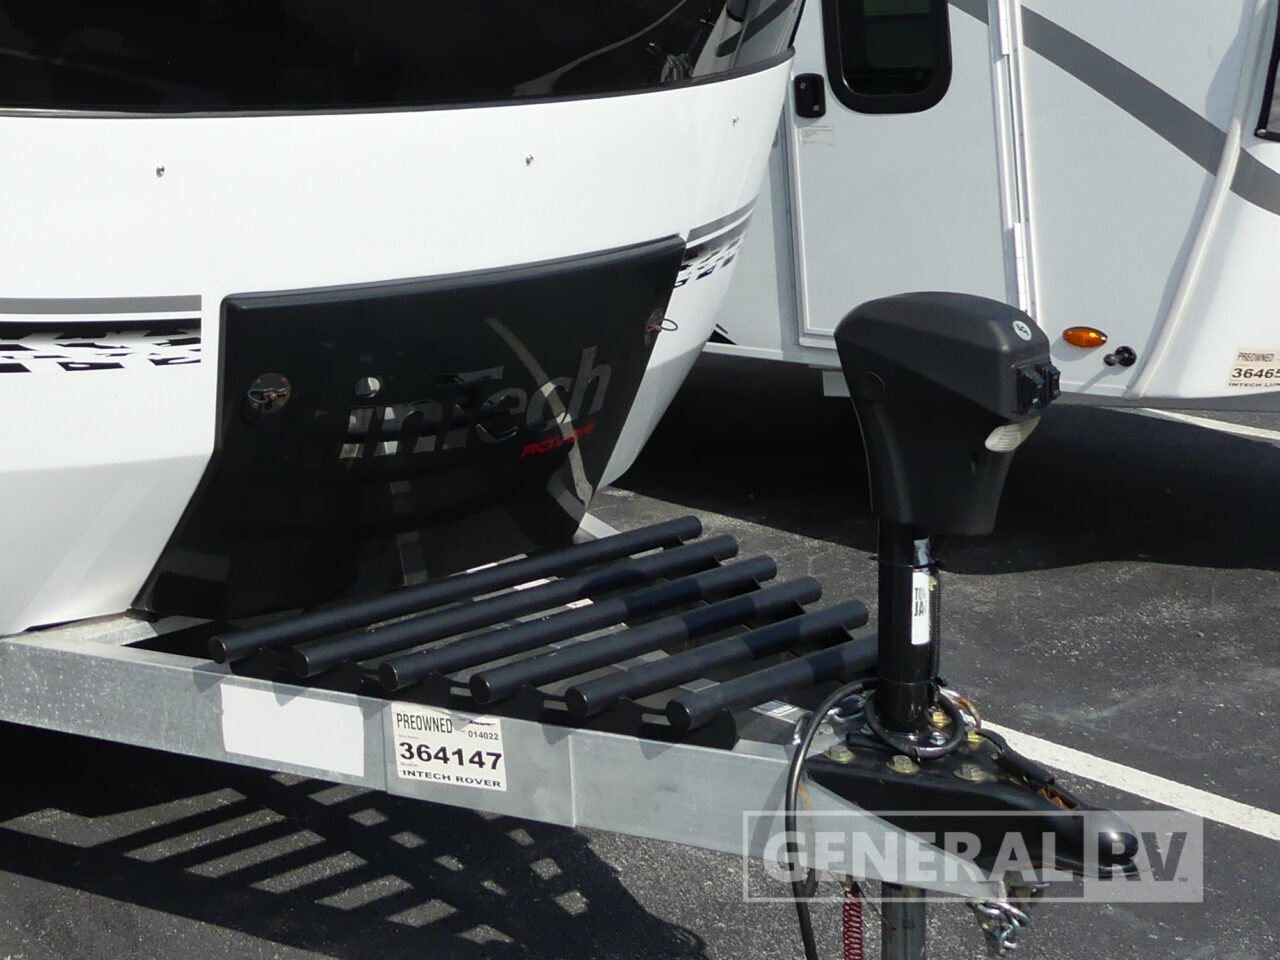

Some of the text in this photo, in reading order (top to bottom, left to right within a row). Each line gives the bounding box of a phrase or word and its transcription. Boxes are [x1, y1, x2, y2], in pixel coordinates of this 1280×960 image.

[396, 713, 453, 734] PREOWNED
[468, 730, 499, 740] 014022
[399, 742, 502, 770] 364147
[402, 769, 501, 787] INTECH ROVER
